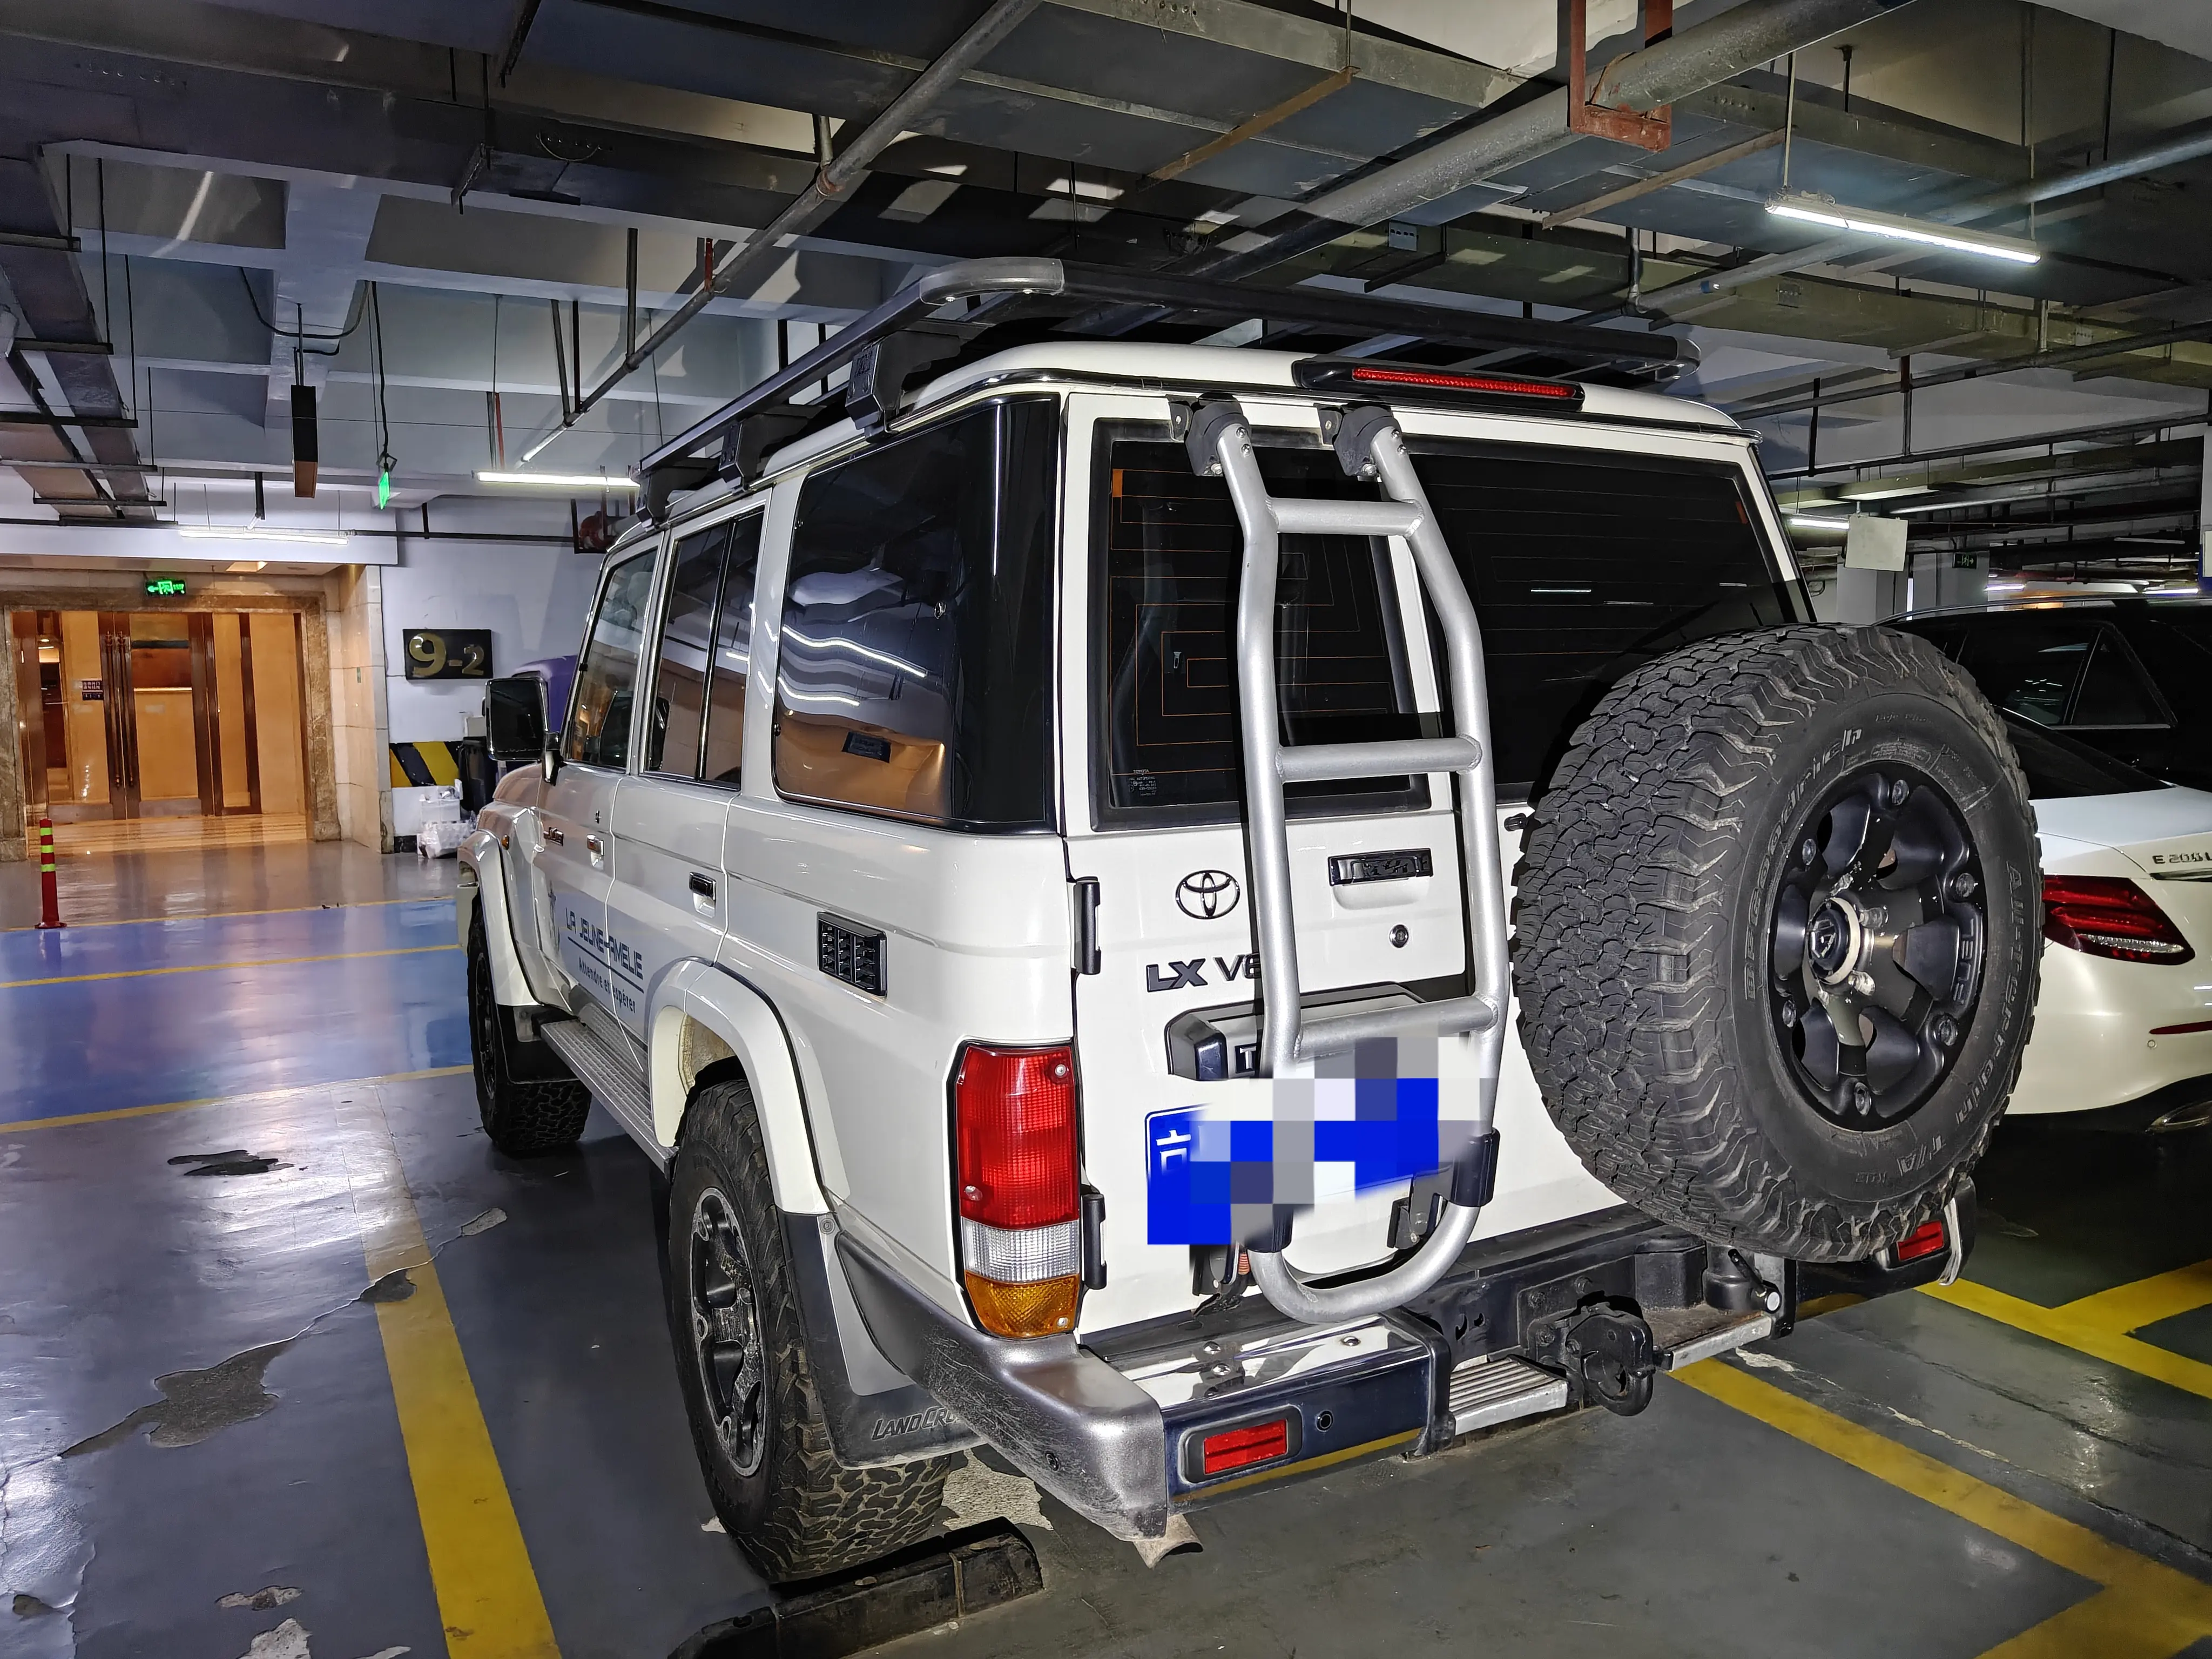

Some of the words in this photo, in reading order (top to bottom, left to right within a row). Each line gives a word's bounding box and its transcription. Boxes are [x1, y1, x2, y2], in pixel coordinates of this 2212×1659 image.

[409, 633, 484, 677] 9-2
[2152, 855, 2166, 864] E
[579, 956, 603, 989] Attendre
[1146, 958, 1208, 992] LX
